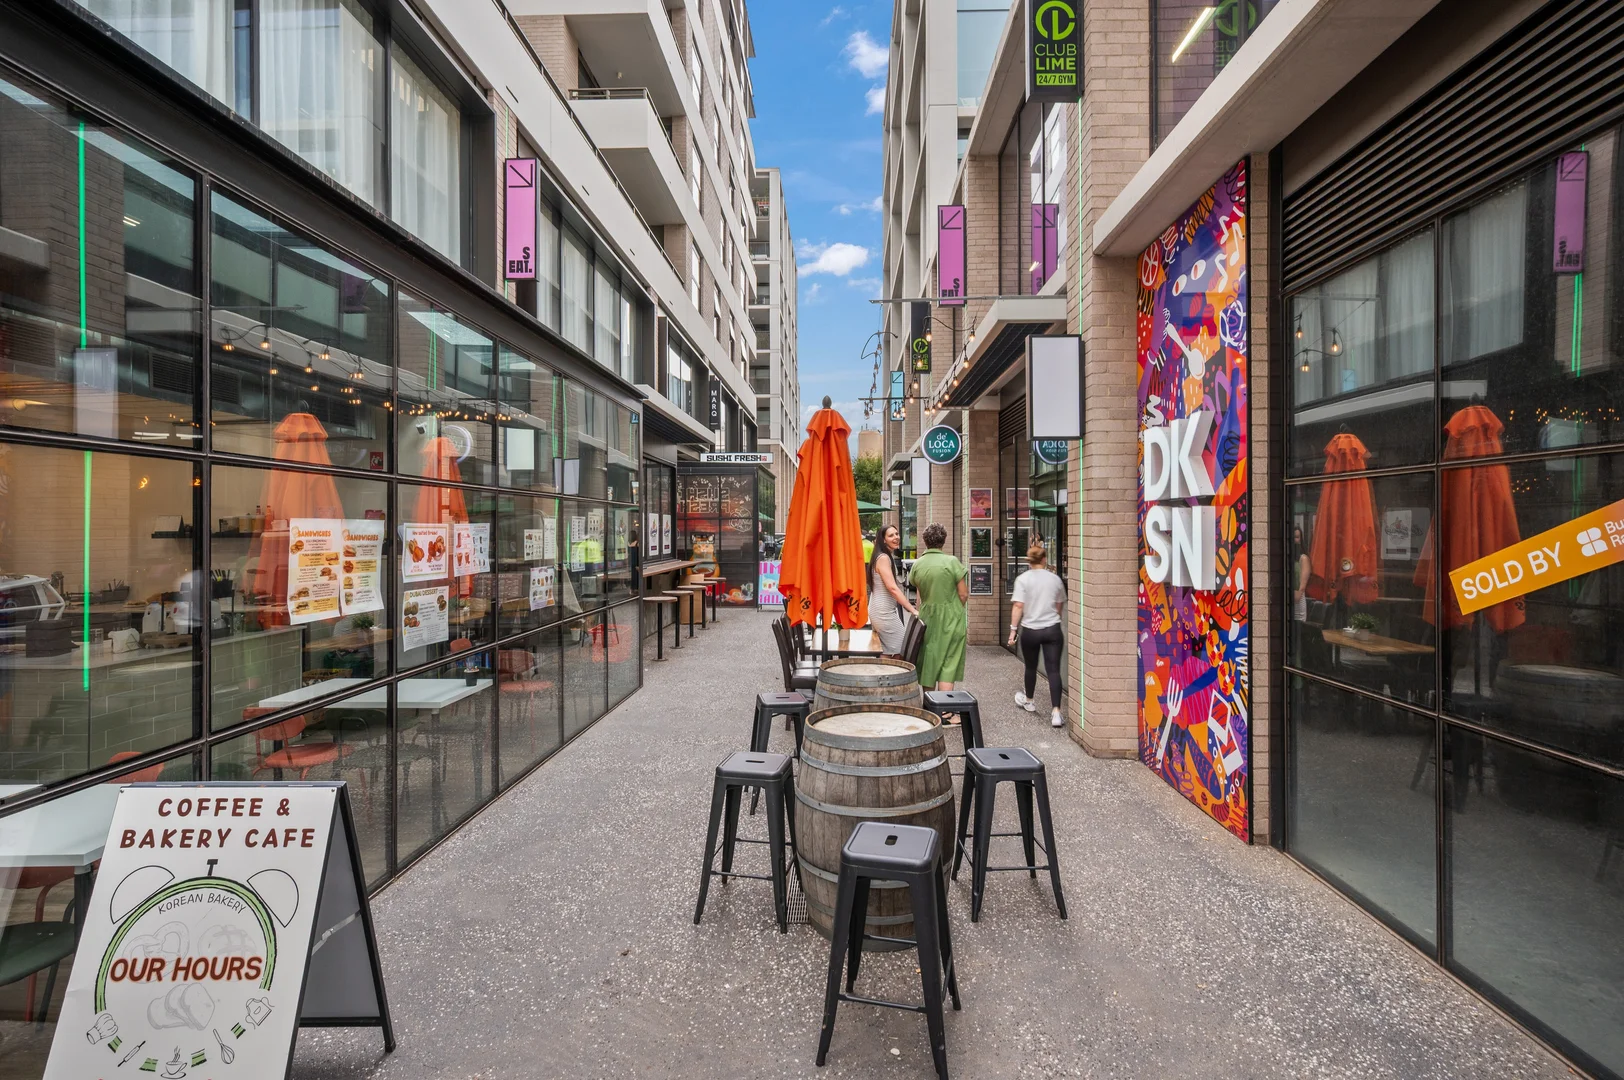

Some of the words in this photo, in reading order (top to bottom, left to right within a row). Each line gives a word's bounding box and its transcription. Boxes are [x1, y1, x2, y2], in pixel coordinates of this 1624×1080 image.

[1034, 43, 1077, 57] CLUB
[1035, 57, 1076, 71] LIME
[1038, 75, 1057, 84] 24/7
[1058, 75, 1074, 84] GYM
[522, 246, 531, 260] S
[508, 260, 533, 273] EAT.
[952, 277, 960, 290] S
[710, 390, 718, 417] MARQ
[928, 440, 956, 449] LOCA
[706, 454, 733, 462] SUSHI
[734, 454, 762, 462] FRESH
[297, 529, 331, 538] SANDWICHES
[1461, 559, 1524, 600] SOLD
[1527, 541, 1561, 576] BY
[158, 798, 263, 817] COFFEE
[276, 798, 290, 817] &
[120, 828, 232, 849] BAKERY
[244, 828, 315, 849] CAFE
[158, 893, 203, 915] KOREAN
[207, 892, 247, 915] BAKERY
[110, 957, 166, 982] OUR
[171, 955, 263, 982] HOURS
